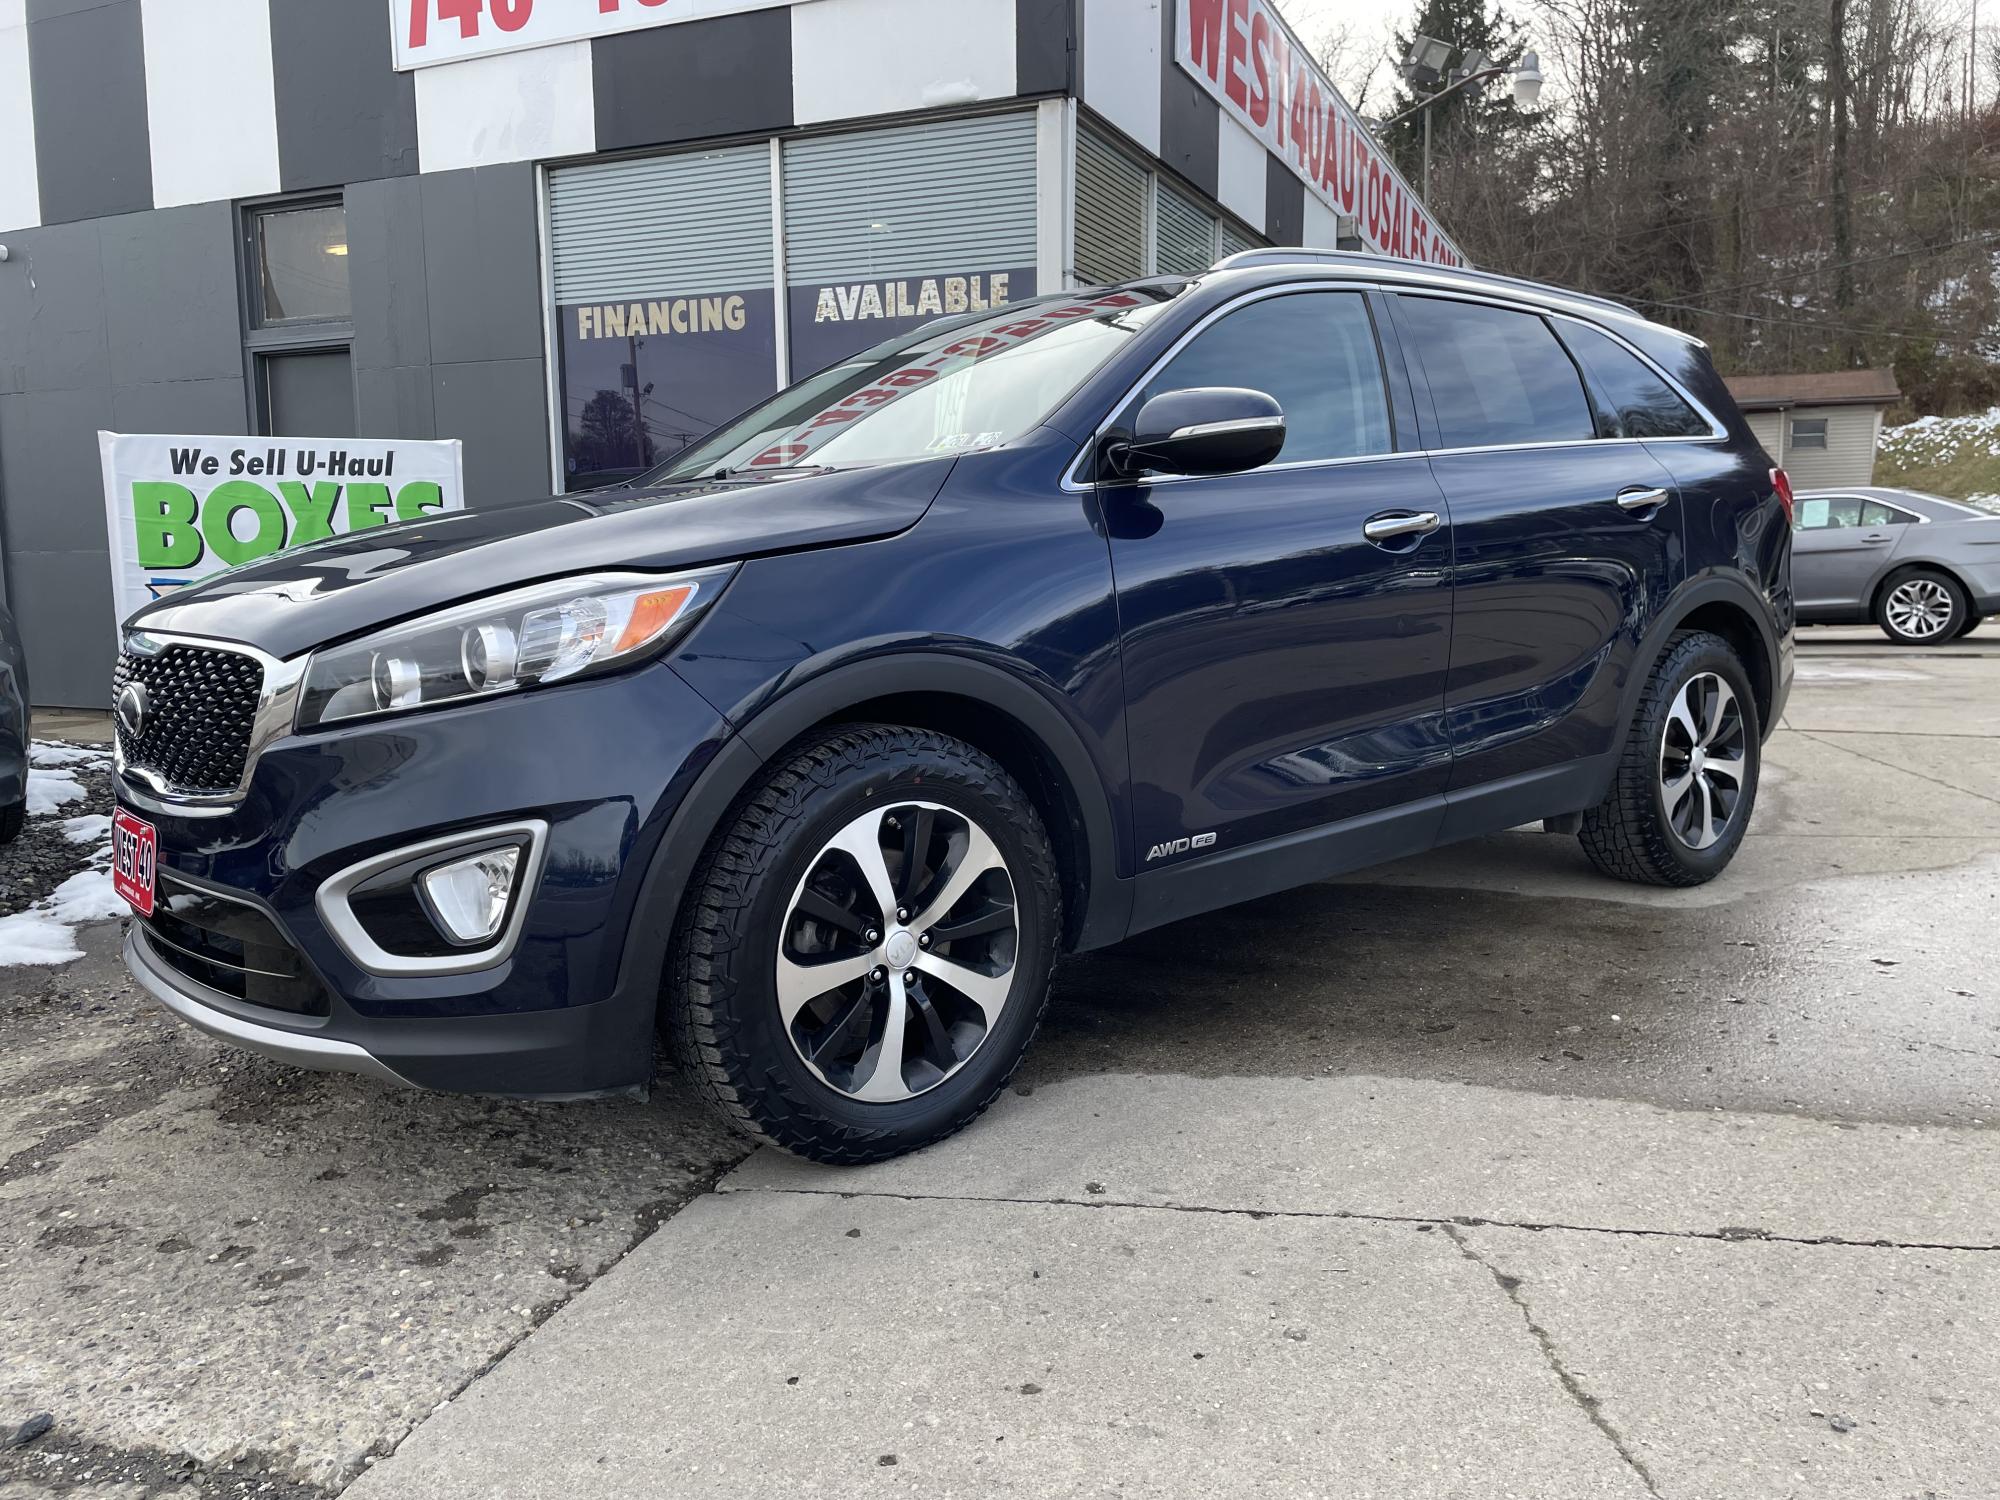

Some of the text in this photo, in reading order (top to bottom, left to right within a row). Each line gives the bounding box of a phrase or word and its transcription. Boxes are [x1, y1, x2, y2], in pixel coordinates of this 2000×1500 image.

[578, 295, 745, 340] FINANCING
[814, 273, 1009, 323] AVAILABLE
[170, 448, 395, 477] We Sell U-Haul
[115, 823, 152, 891] WEST 40
[1145, 838, 1190, 861] AWD
